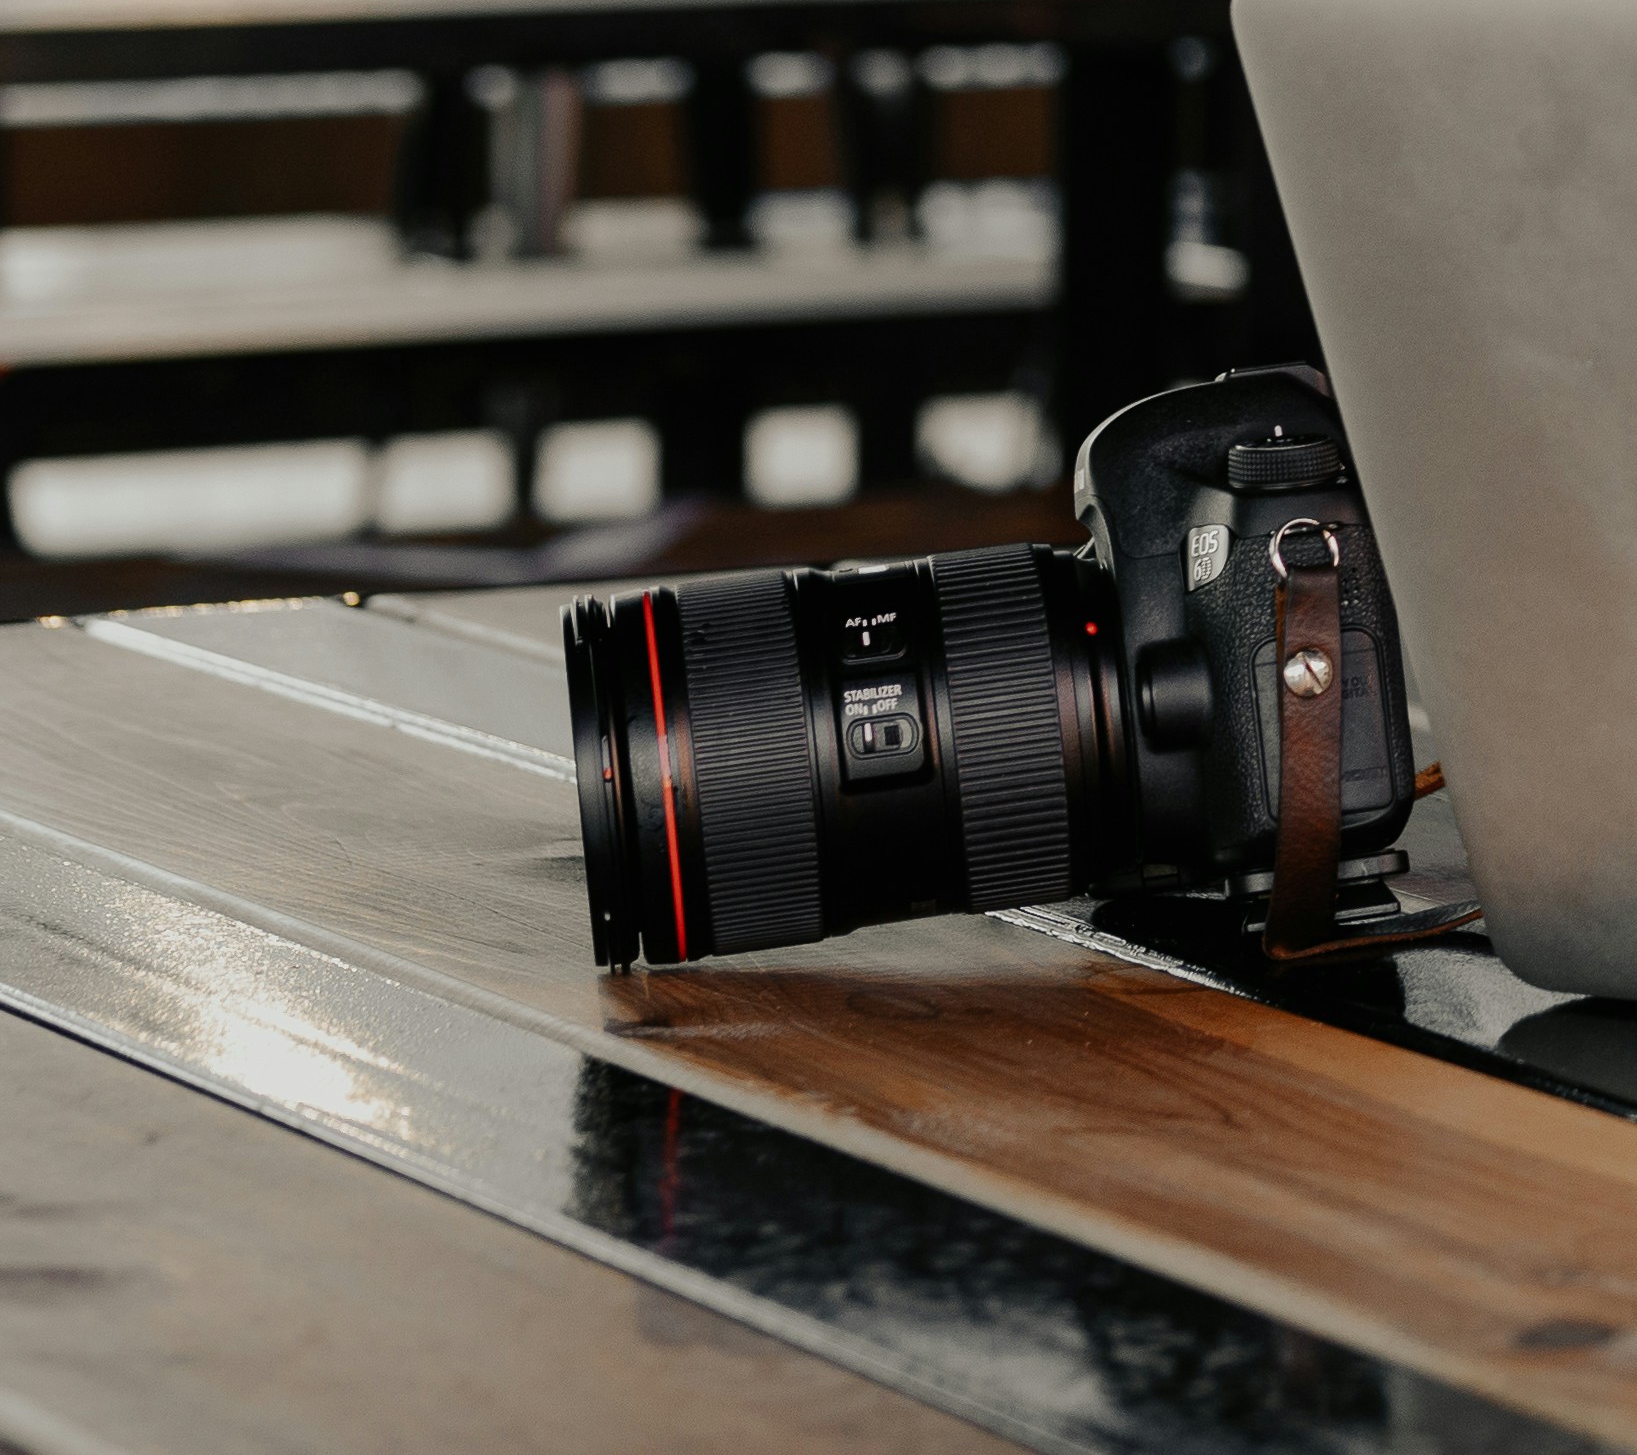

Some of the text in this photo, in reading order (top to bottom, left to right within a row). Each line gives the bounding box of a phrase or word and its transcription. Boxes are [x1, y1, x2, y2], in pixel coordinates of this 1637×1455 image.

[1191, 529, 1219, 557] EOS
[845, 612, 897, 628] AF MF
[843, 684, 903, 703] STABILIZER
[845, 698, 898, 716] ON OFF
